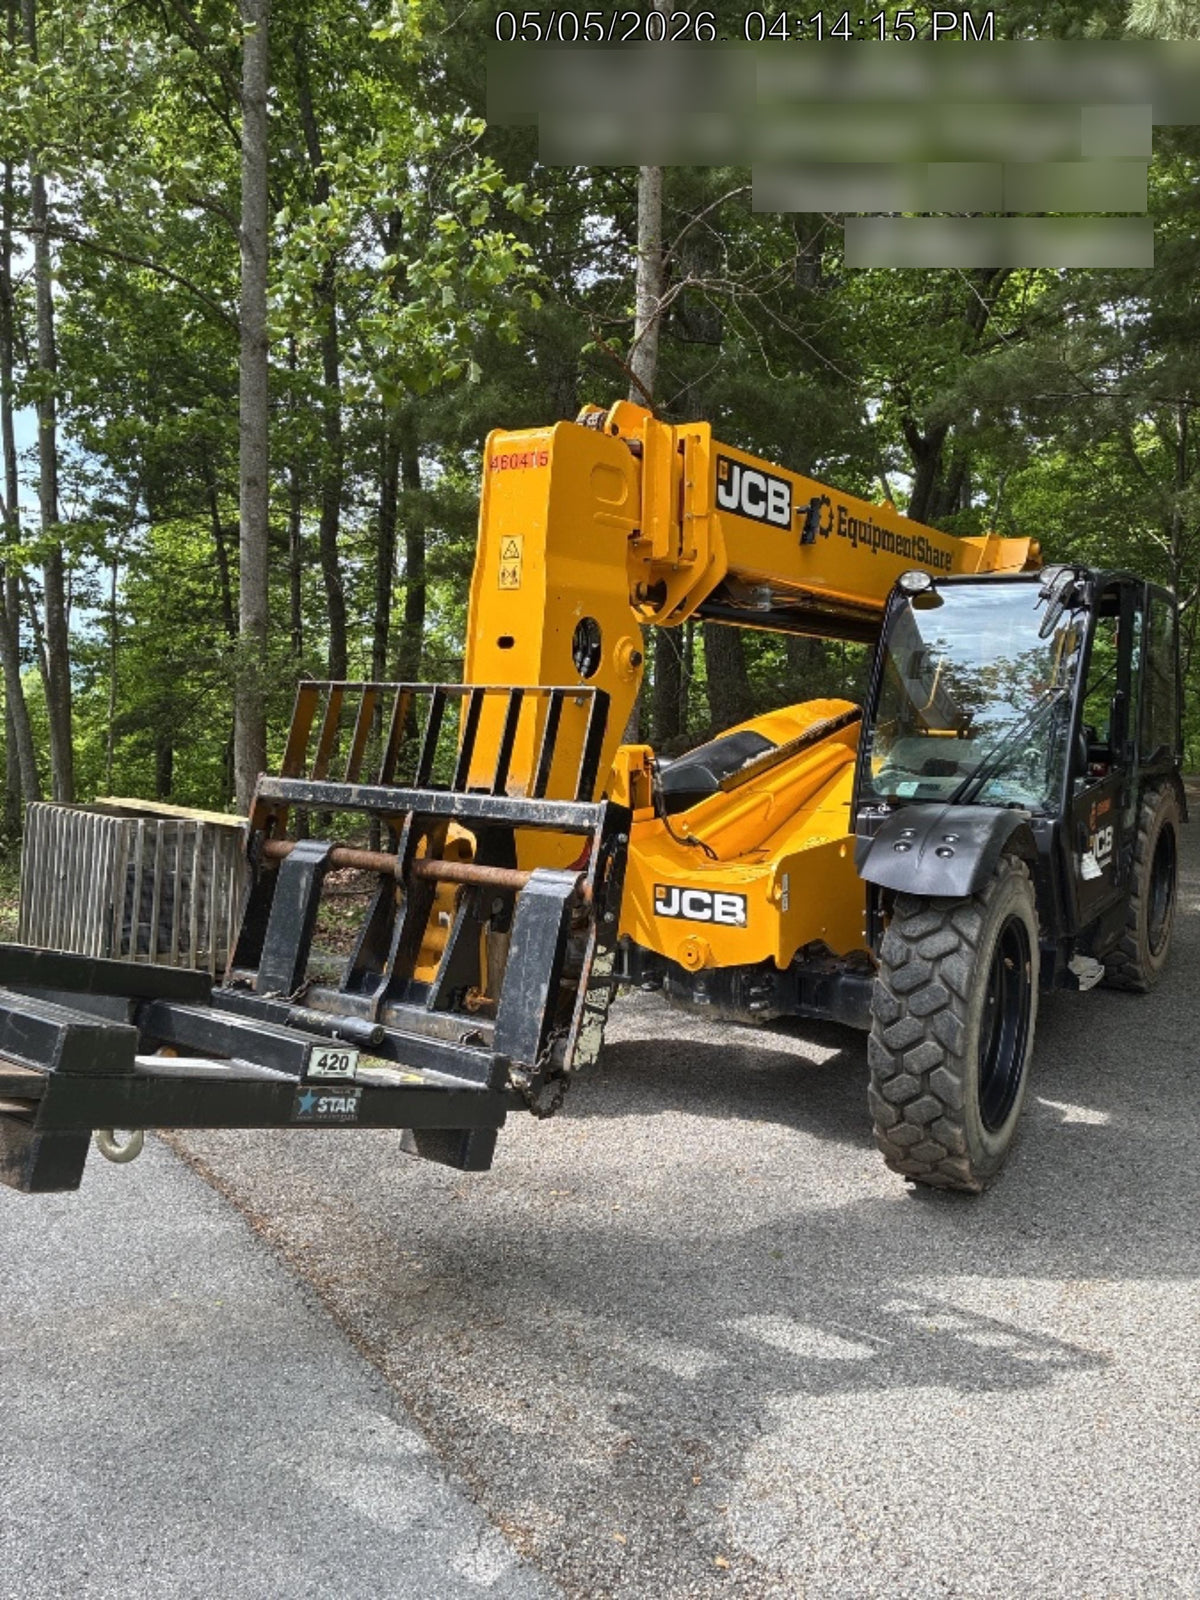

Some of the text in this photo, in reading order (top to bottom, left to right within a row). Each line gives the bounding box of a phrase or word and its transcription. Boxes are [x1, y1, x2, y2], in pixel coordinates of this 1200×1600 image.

[717, 464, 791, 525] JCB
[836, 504, 953, 571] EquipmentShare
[655, 887, 746, 924] JCB
[317, 1053, 349, 1071] 420
[317, 1097, 357, 1114] STAR
